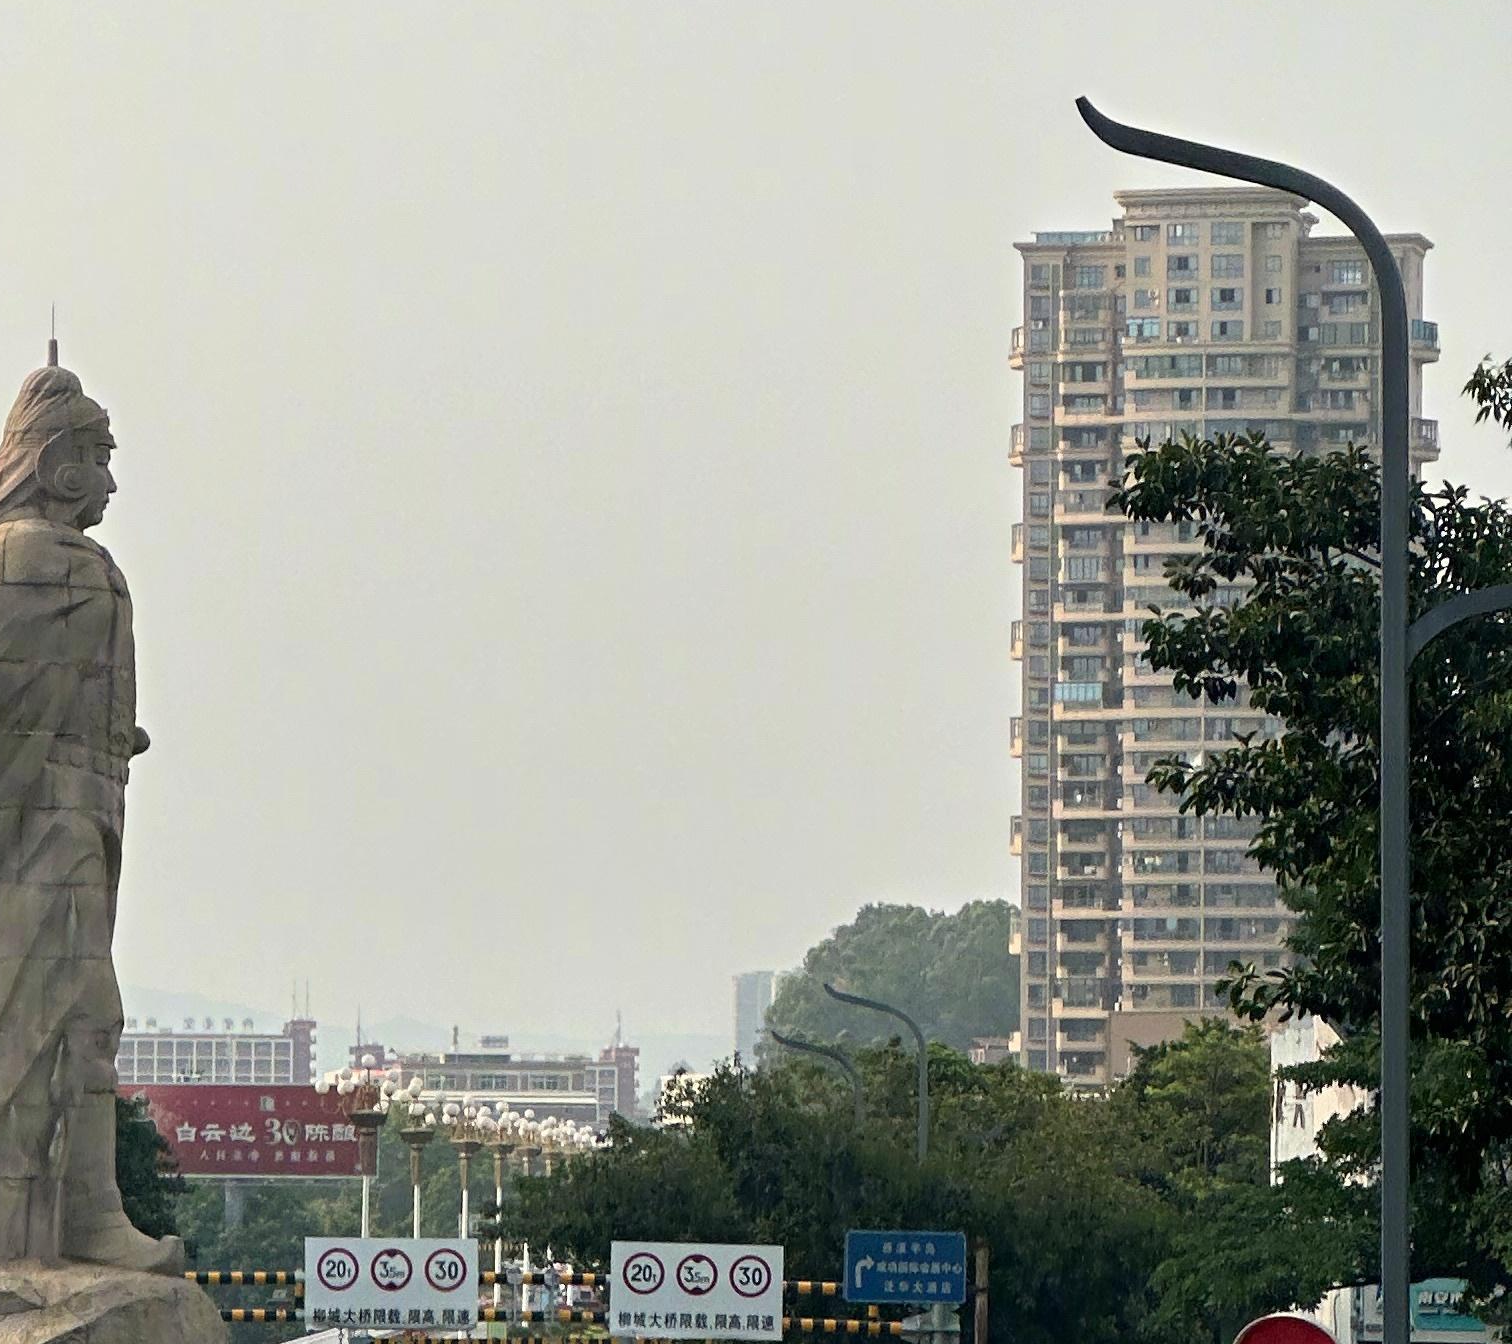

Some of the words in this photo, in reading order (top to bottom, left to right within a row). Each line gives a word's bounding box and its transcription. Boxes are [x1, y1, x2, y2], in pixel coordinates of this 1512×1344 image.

[175, 1121, 256, 1144] 白云边
[264, 1117, 302, 1146] 30
[434, 1260, 459, 1280] 30
[630, 1263, 657, 1284] 20t
[738, 1266, 763, 1286] 30
